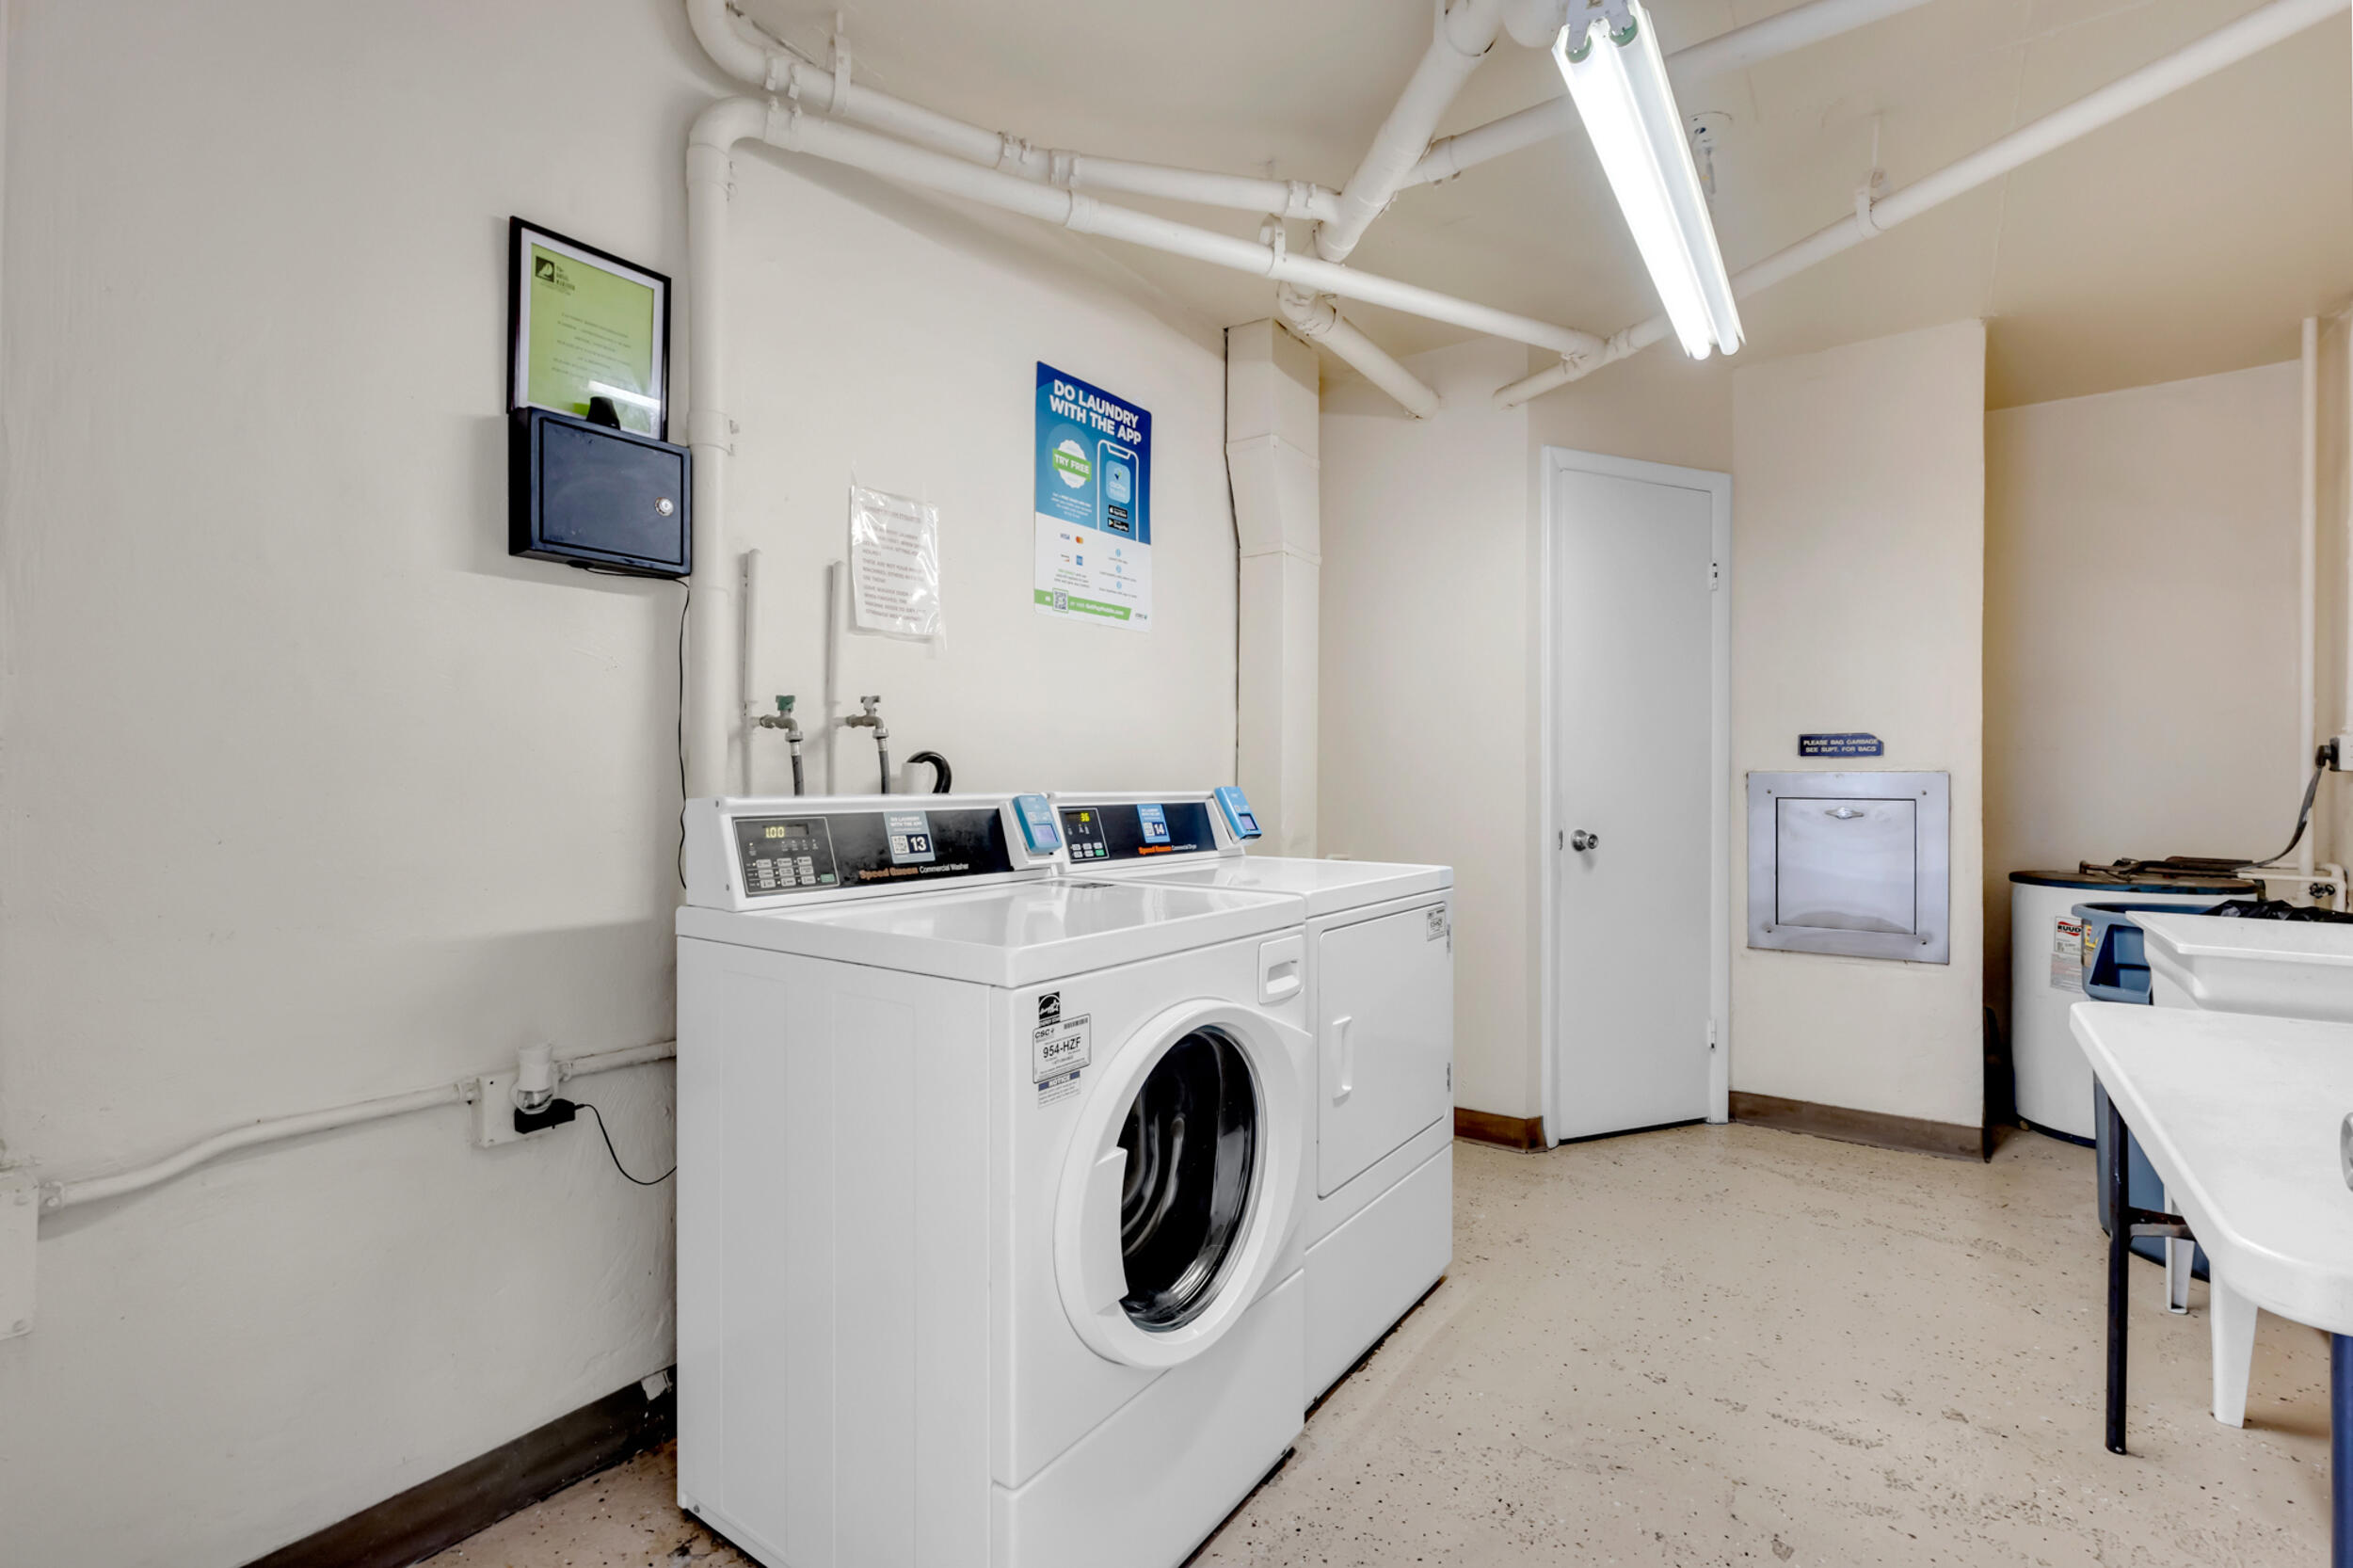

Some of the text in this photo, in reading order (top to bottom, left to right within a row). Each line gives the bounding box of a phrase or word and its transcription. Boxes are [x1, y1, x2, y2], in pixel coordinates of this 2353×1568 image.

[1054, 379, 1139, 428] DO LAUNDRY
[1049, 394, 1142, 445] WITH THE APP
[1054, 454, 1090, 474] TRY FREE
[1154, 824, 1165, 835] 14
[910, 836, 927, 852] 13
[858, 868, 889, 880] Speed
[889, 867, 919, 876] Queen
[920, 864, 950, 873] Commercial
[1034, 1029, 1050, 1039] CSC
[1043, 1036, 1081, 1059] 954-HZF
